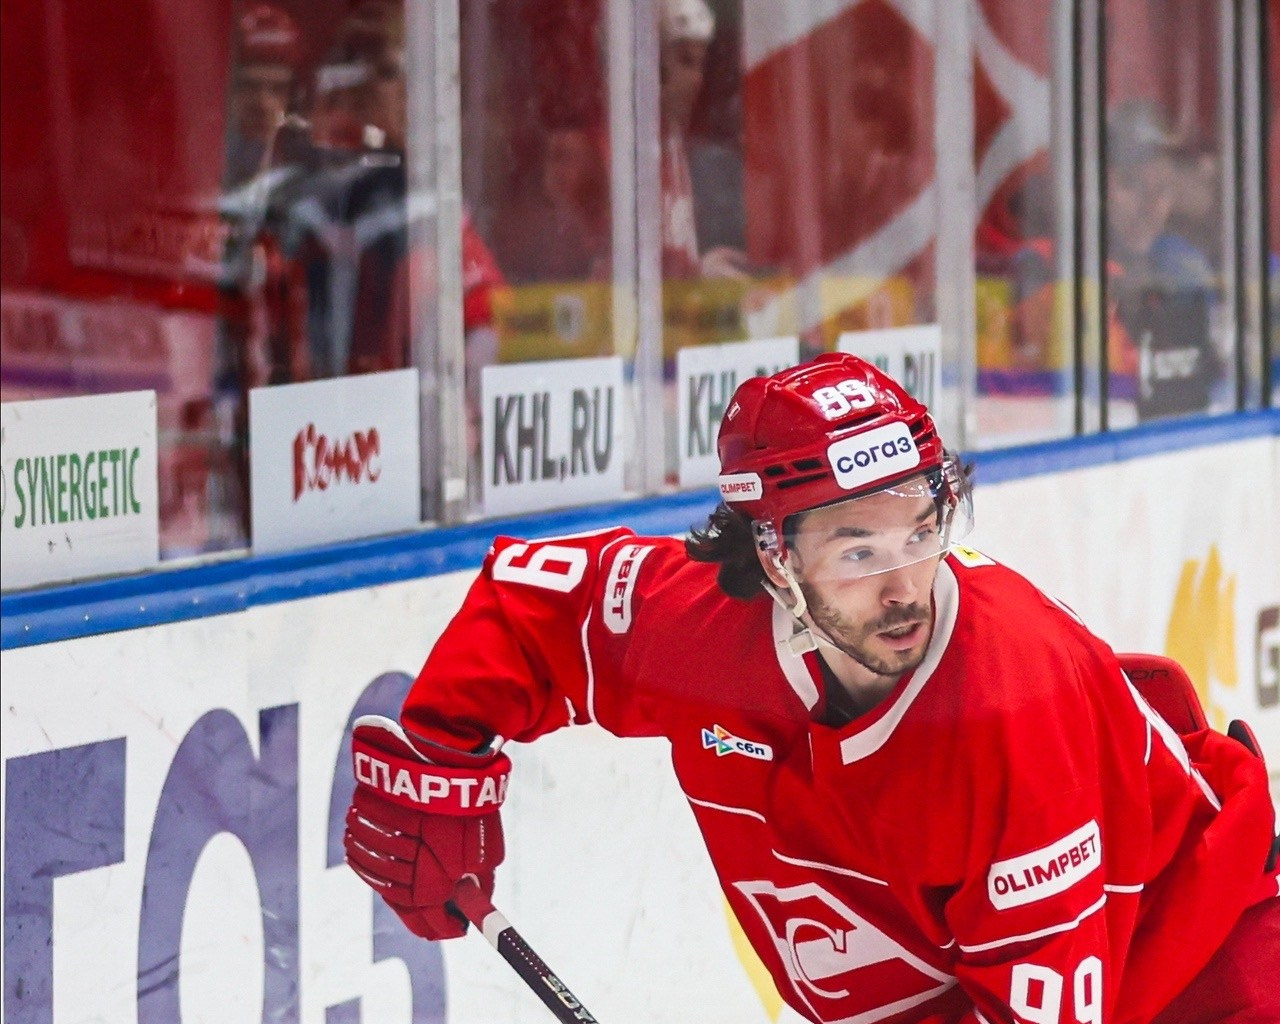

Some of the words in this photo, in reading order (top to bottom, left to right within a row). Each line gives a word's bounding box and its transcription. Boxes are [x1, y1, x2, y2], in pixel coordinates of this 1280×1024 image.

[811, 379, 876, 421] 99
[837, 436, 912, 474] согаз
[14, 446, 141, 529] SYNERGETIC
[721, 481, 756, 494] OLIMPBET
[735, 741, 765, 756] сбп
[994, 834, 1096, 895] OLIMPBET
